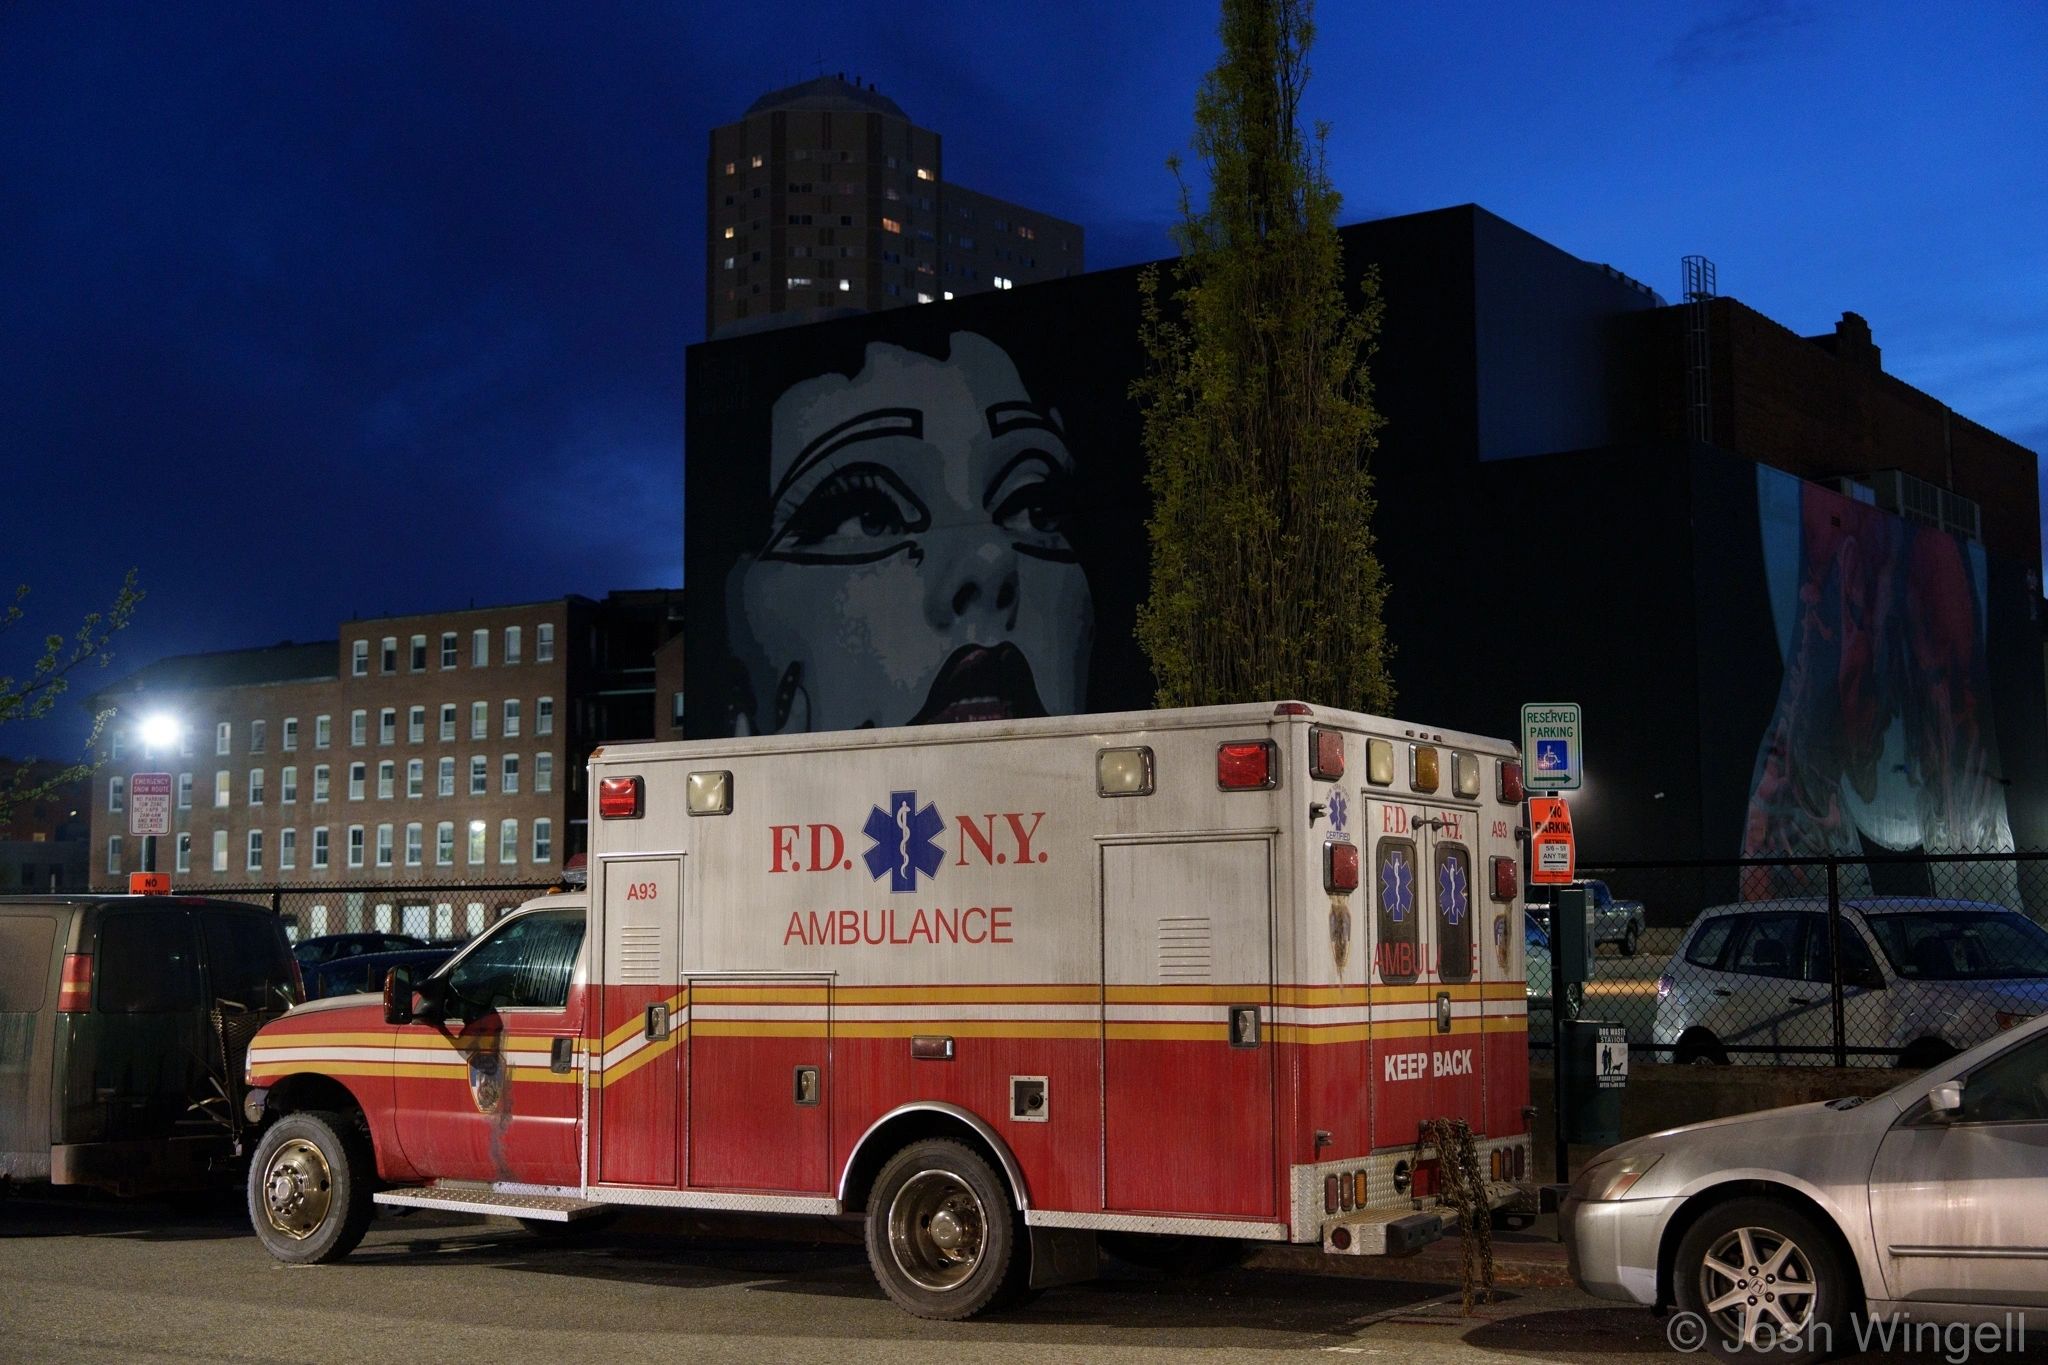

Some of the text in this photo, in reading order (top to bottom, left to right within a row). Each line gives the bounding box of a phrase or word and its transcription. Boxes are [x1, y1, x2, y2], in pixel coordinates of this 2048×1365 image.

[1527, 712, 1576, 723] RESERVED
[1530, 726, 1573, 738] PARKING
[1383, 804, 1409, 834] F.D.
[1549, 806, 1562, 819] NO
[1326, 830, 1351, 842] CERTIFIED
[1492, 820, 1508, 838] A93
[1535, 821, 1571, 835] PARKING
[768, 812, 1048, 873] F.D. N.Y.
[145, 878, 158, 888] NO
[627, 882, 657, 900] A93
[783, 907, 1014, 946] AMBULANCE
[1372, 942, 1478, 976] AMBULE
[1384, 1048, 1473, 1082] KEEP BACK
